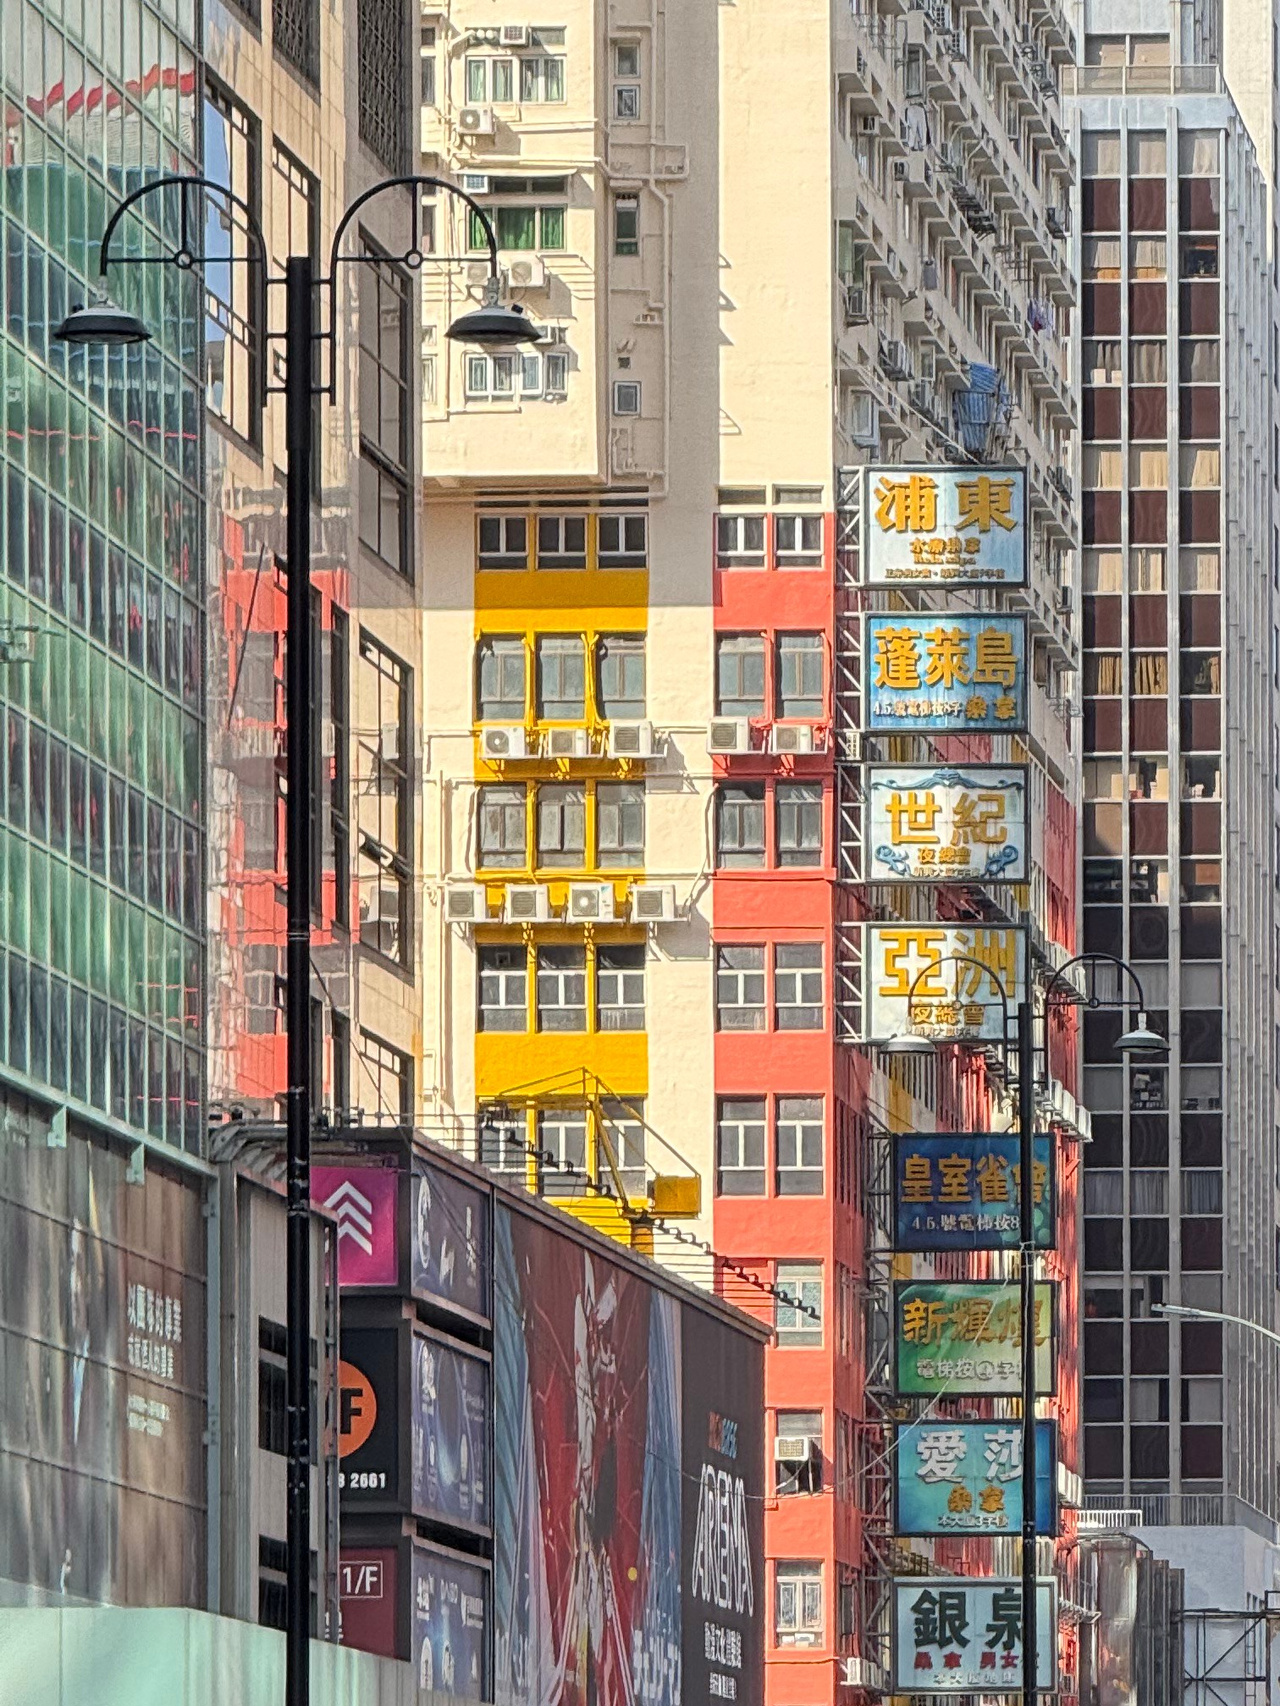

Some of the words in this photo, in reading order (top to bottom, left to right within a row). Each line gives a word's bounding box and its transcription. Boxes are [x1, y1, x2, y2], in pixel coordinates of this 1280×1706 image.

[874, 474, 1017, 534] 浦東
[874, 626, 1018, 691] 蓬萊島
[885, 791, 1008, 846] 世紀
[917, 846, 971, 865] 夜總會
[879, 929, 1016, 998] 亞洲
[900, 1153, 1048, 1204] 皇室雀會
[903, 1297, 1048, 1348] 新輝煌
[916, 1429, 1023, 1484] 愛莎
[692, 1462, 754, 1619] ARENA
[342, 1565, 379, 1595] 1/F
[910, 1587, 1023, 1650] 銀泉
[979, 1650, 1040, 1671] 男女
